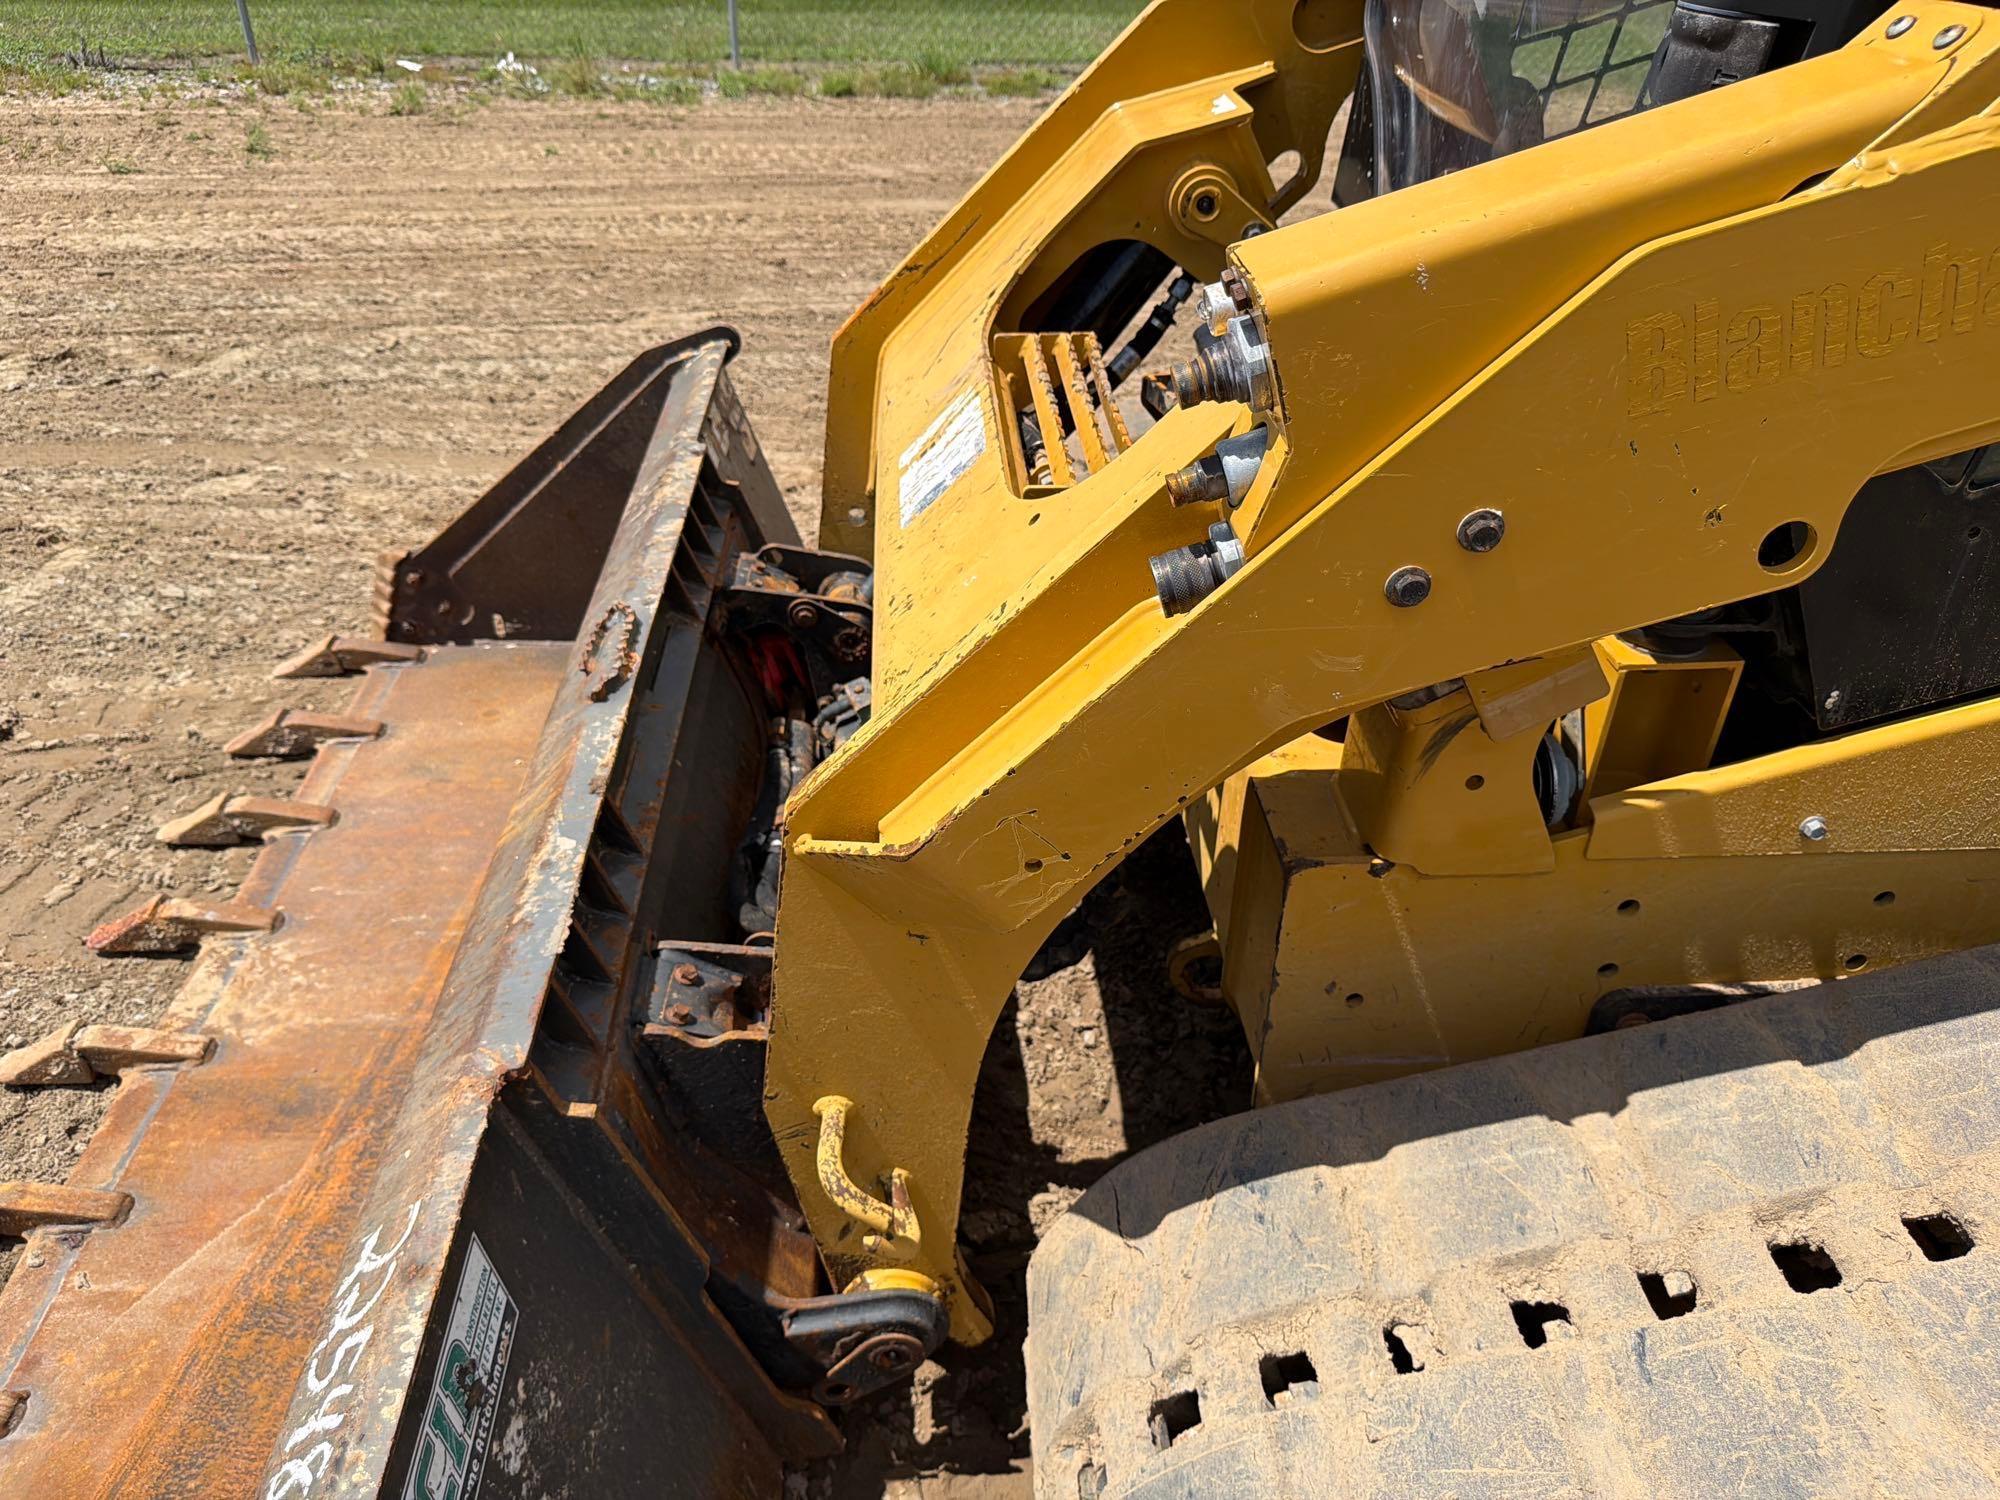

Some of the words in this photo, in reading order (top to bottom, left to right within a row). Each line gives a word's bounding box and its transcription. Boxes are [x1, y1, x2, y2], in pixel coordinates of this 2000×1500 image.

[465, 1265, 489, 1346] CONSTRUCTION
[473, 1279, 498, 1362] IMPLEMENTS
[475, 1320, 513, 1454] Attachments
[480, 1326, 497, 1375] DEPOT
